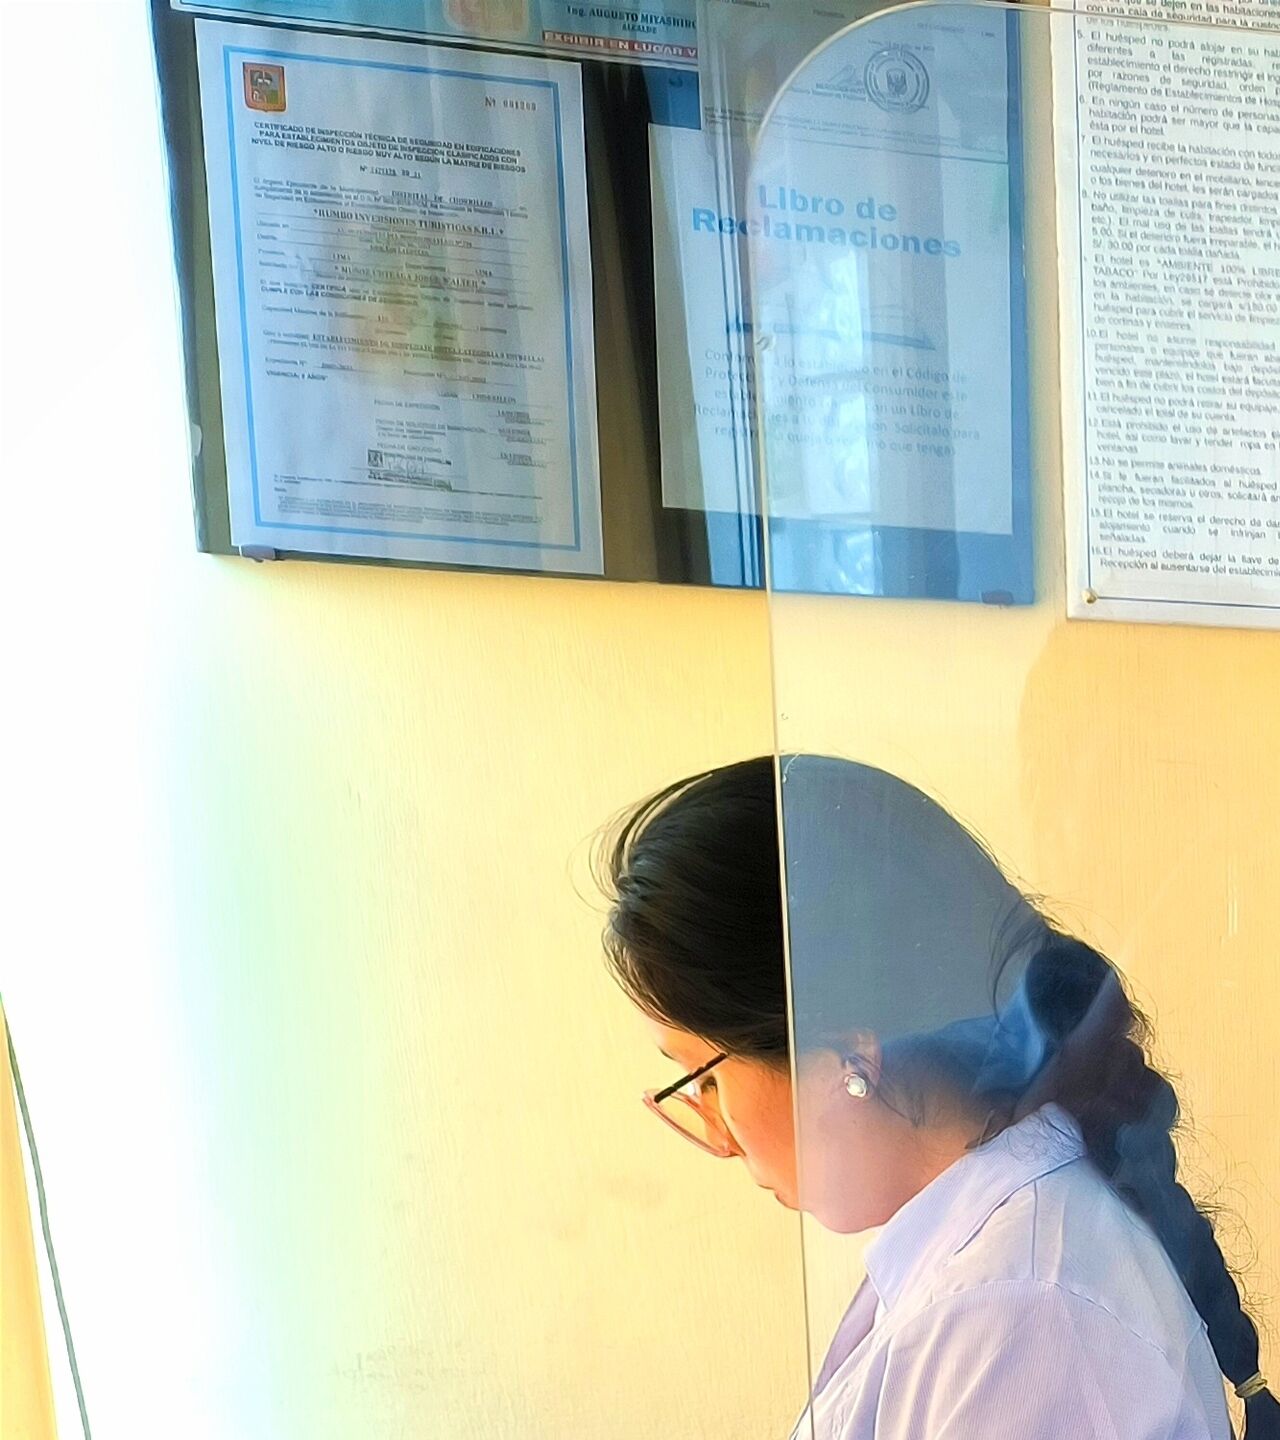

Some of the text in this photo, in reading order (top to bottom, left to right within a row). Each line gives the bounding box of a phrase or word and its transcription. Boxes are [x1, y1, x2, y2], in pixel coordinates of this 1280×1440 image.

[589, 7, 638, 22] AUGUSTO
[609, 39, 629, 50] EN
[634, 42, 682, 55] LUGAR
[1151, 38, 1163, 46] no
[1231, 46, 1242, 54] en
[1248, 48, 1259, 56] su
[254, 122, 303, 133] CERTIFICADO
[305, 127, 316, 135] DE
[398, 136, 407, 144] DE
[454, 142, 464, 150] EN
[260, 131, 280, 139] PARA
[251, 138, 272, 147] NIVEL
[274, 140, 285, 148] DE
[317, 144, 337, 153] ALTO
[393, 152, 413, 161] ALTO
[442, 157, 452, 165] LA
[482, 162, 492, 170] DE
[759, 185, 897, 222] Libro de
[691, 207, 962, 257] Reclamaciones
[1150, 561, 1158, 570] al
[1213, 565, 1226, 574] del
[1268, 556, 1279, 565] de
